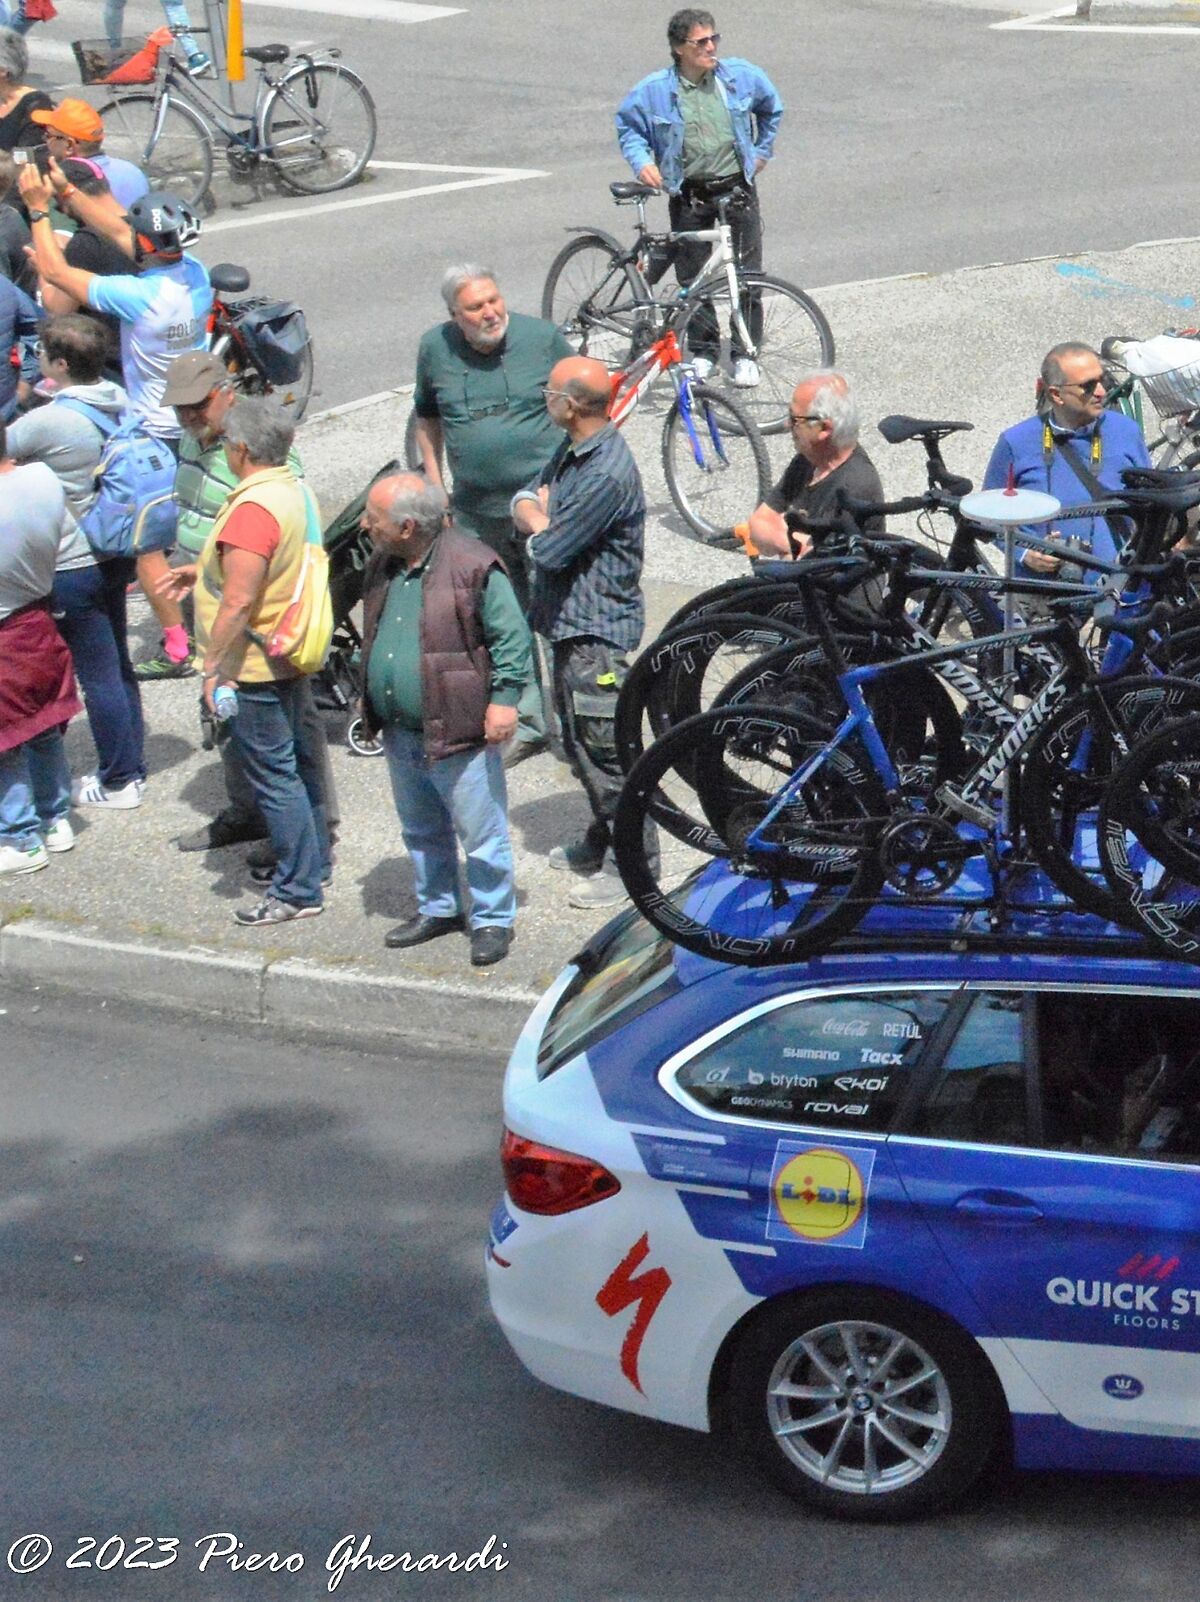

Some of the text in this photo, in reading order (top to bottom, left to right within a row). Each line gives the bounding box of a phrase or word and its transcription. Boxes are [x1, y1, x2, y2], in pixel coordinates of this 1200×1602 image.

[860, 1048, 904, 1065] Tacx
[770, 1071, 818, 1089] bryton
[804, 1101, 870, 1115] roval
[1045, 1276, 1160, 1313] QUICK
[1113, 1314, 1181, 1331] FLOORS
